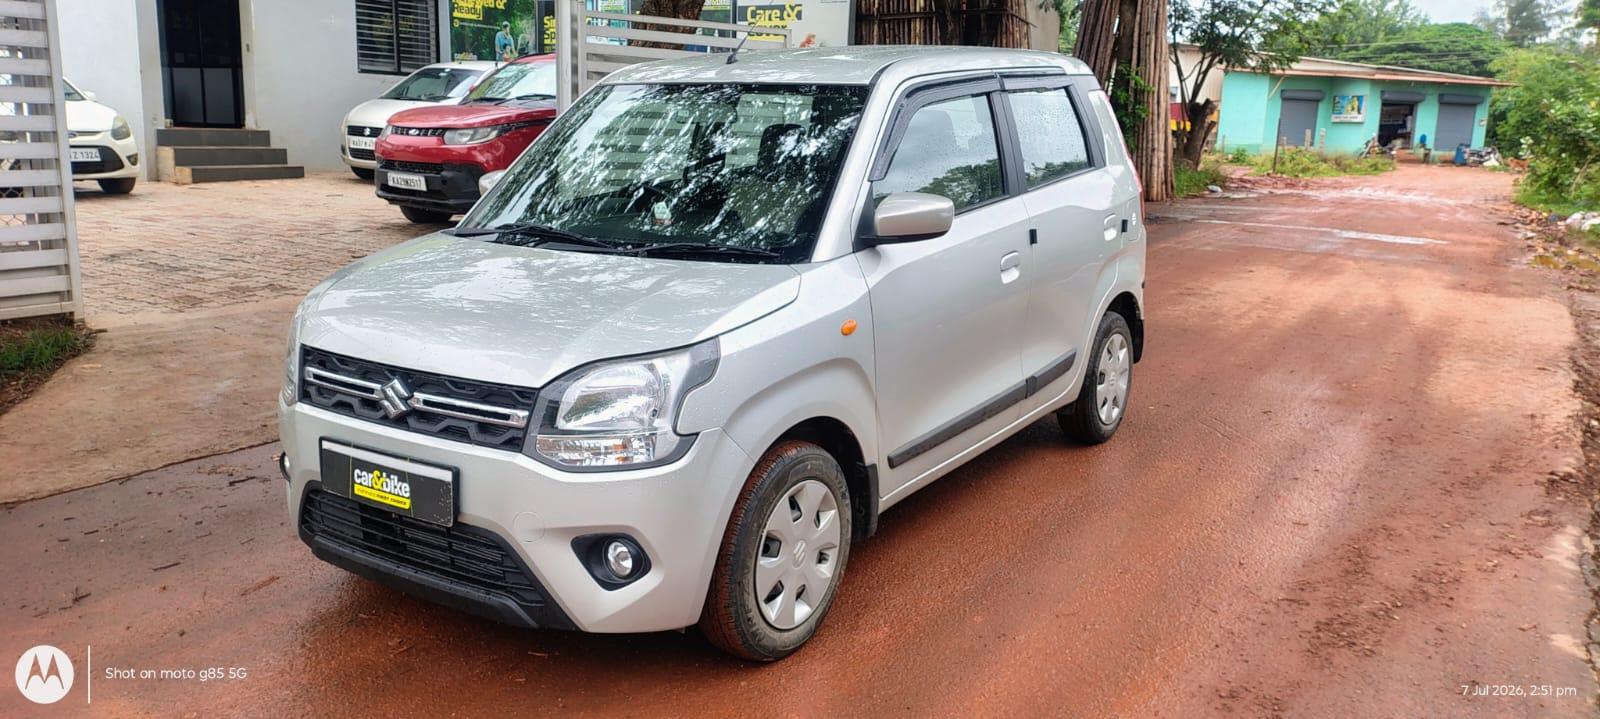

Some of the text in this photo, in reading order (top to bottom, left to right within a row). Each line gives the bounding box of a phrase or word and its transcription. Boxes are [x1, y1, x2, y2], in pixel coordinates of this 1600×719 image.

[453, 2, 481, 19] Ready
[747, 0, 802, 22] Care &
[354, 469, 410, 498] car&bike
